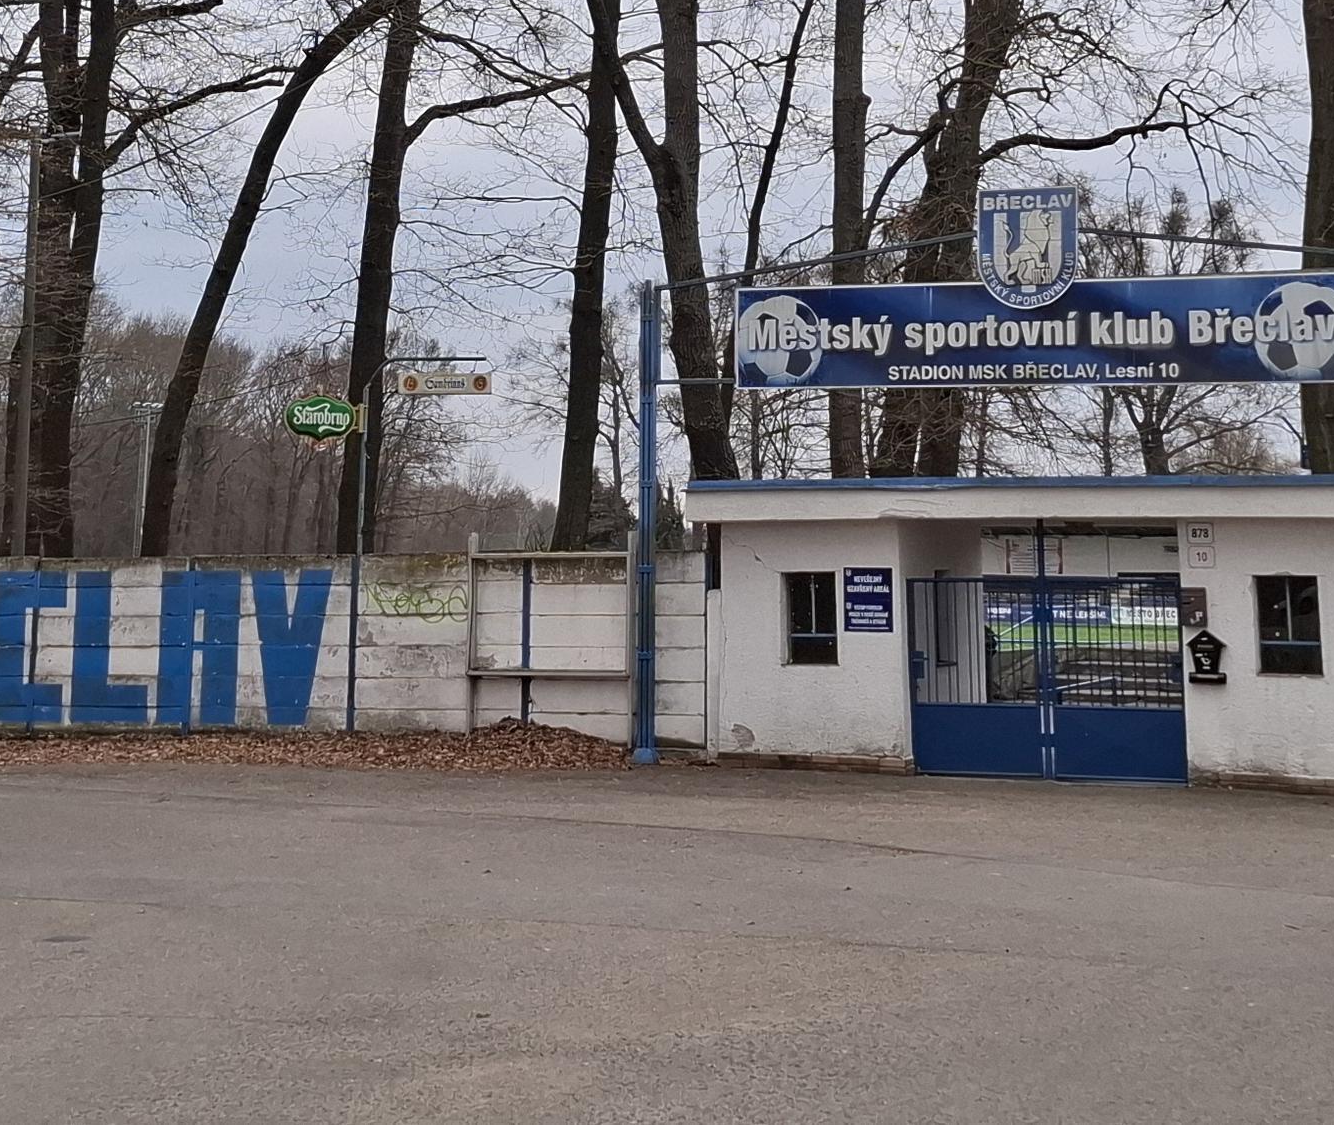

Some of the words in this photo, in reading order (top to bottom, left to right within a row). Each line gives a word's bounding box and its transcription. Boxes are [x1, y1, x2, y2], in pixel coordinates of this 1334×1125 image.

[982, 194, 1073, 211] BŘECLAV
[748, 316, 892, 356] Městský
[905, 311, 1077, 355] sportovní
[1090, 311, 1174, 346] klub
[888, 364, 963, 380] STADION
[969, 363, 1007, 379] MSK
[1013, 360, 1100, 380] BŘECLAV,
[1105, 362, 1154, 378] Lesní
[1158, 363, 1179, 378] 10
[293, 403, 350, 433] Starobrno
[1196, 551, 1207, 562] 10
